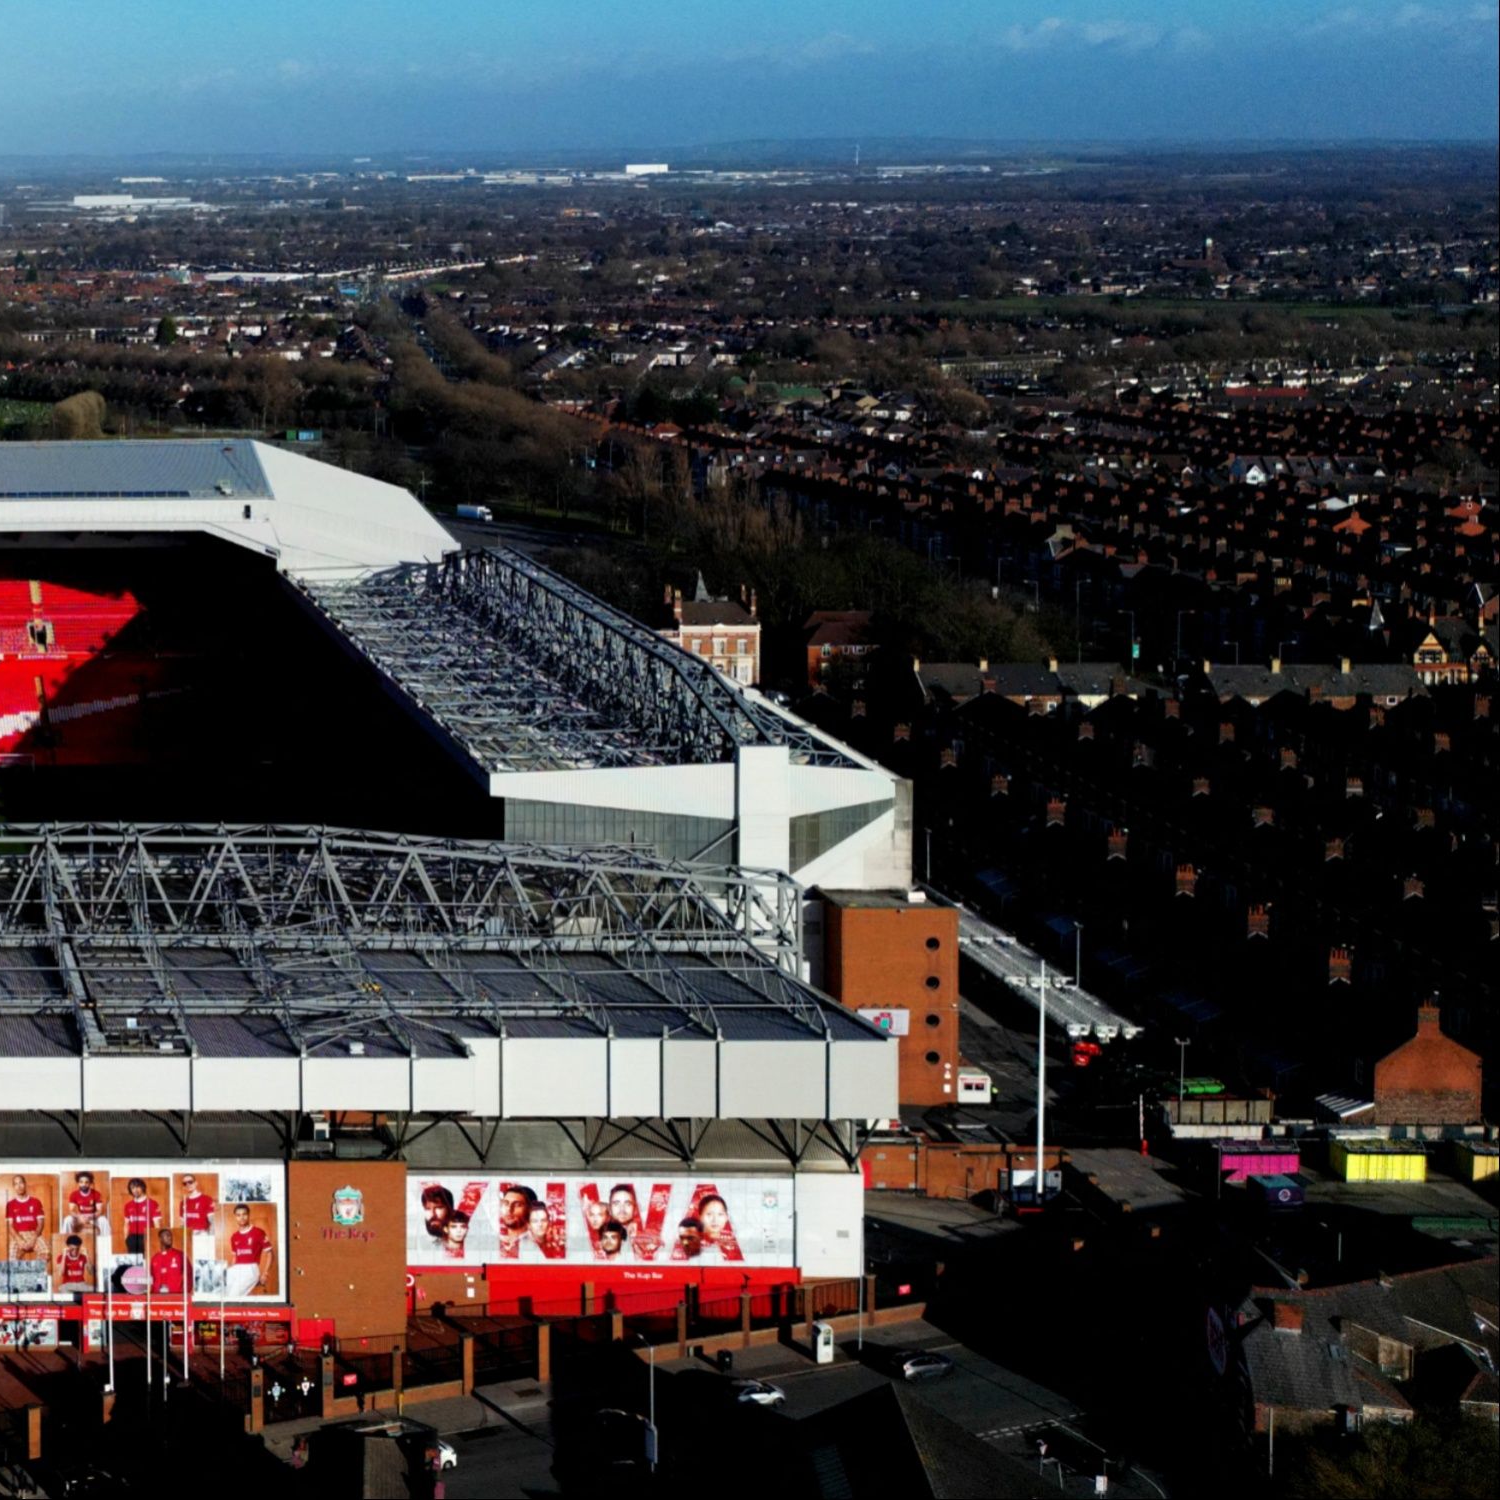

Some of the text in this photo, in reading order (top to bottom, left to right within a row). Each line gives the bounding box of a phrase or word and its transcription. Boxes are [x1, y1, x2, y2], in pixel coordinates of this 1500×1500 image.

[417, 1181, 745, 1261] YNWA
[320, 1226, 376, 1242] The Kop
[623, 1271, 664, 1280] The Kop Bar
[159, 1309, 173, 1318] Kop
